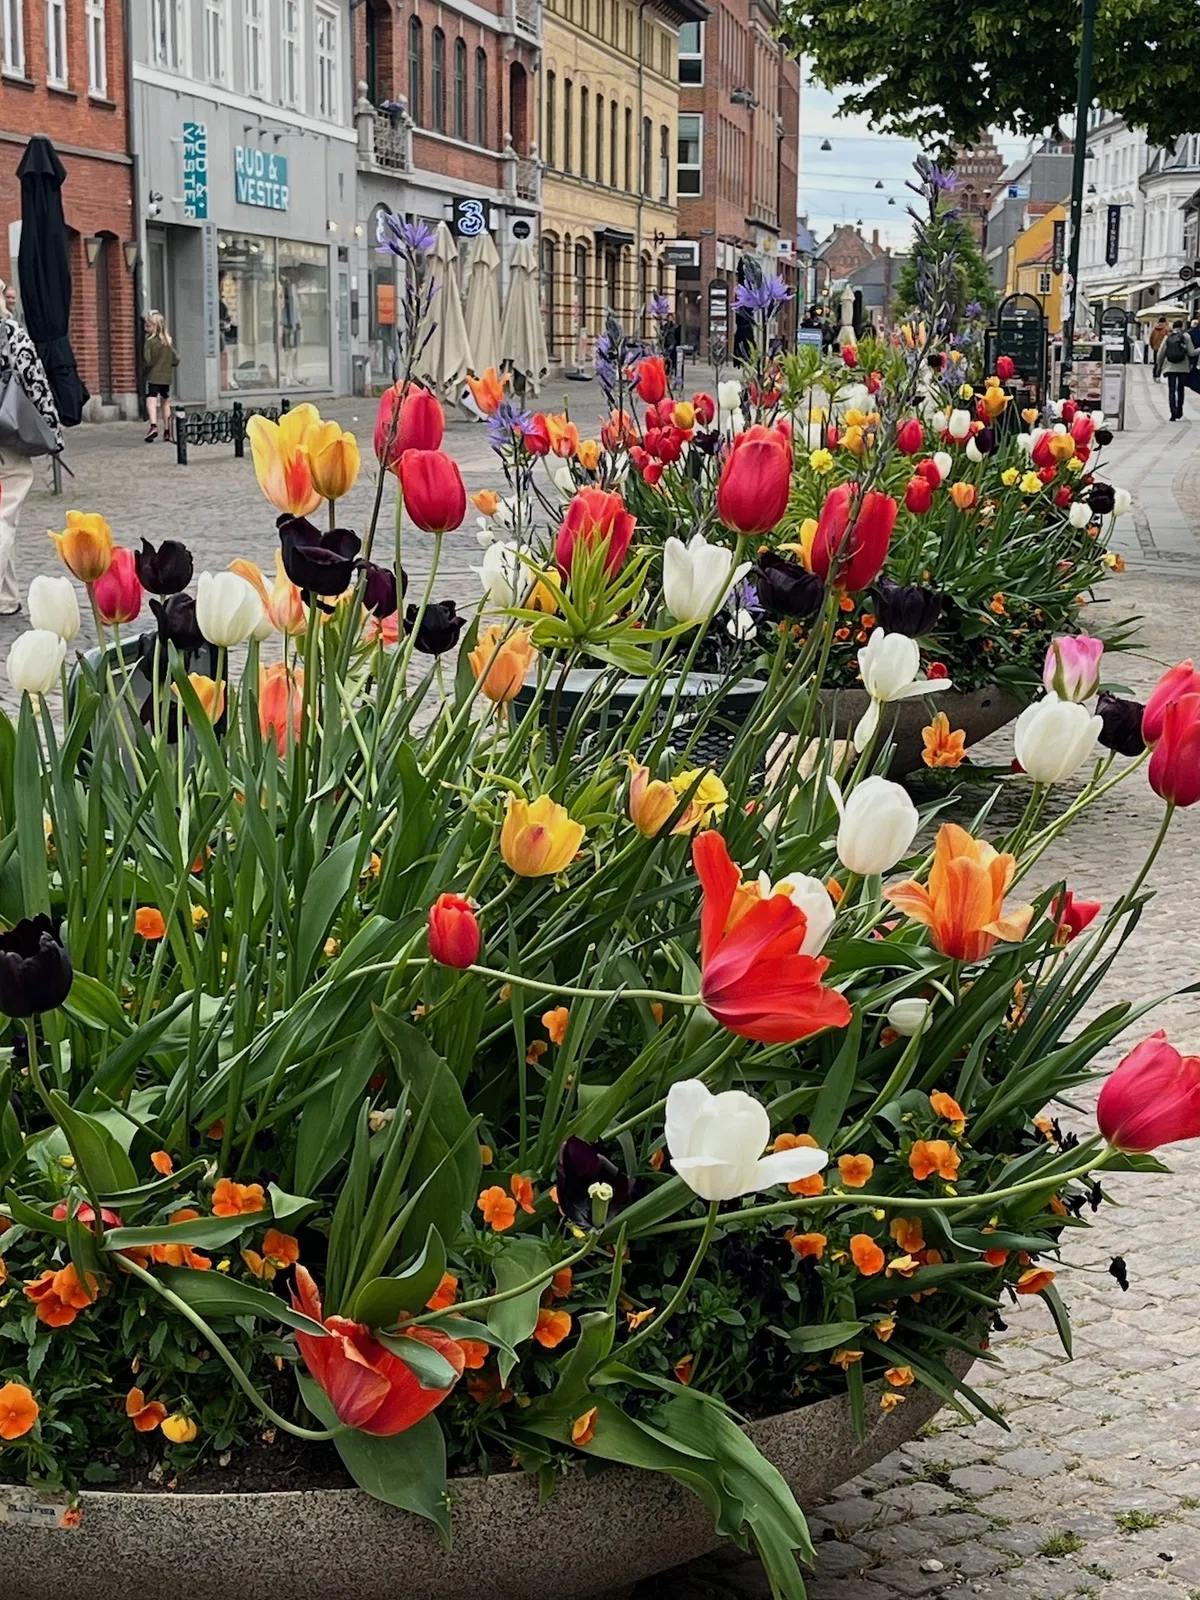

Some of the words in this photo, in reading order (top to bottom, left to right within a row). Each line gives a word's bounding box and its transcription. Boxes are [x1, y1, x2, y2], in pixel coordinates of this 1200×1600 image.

[194, 122, 208, 173] RUD
[235, 145, 265, 177] RUD
[268, 153, 279, 181] &
[183, 126, 196, 219] VESTER
[195, 182, 208, 198] &
[237, 176, 289, 210] VESTER
[457, 199, 485, 235] 3
